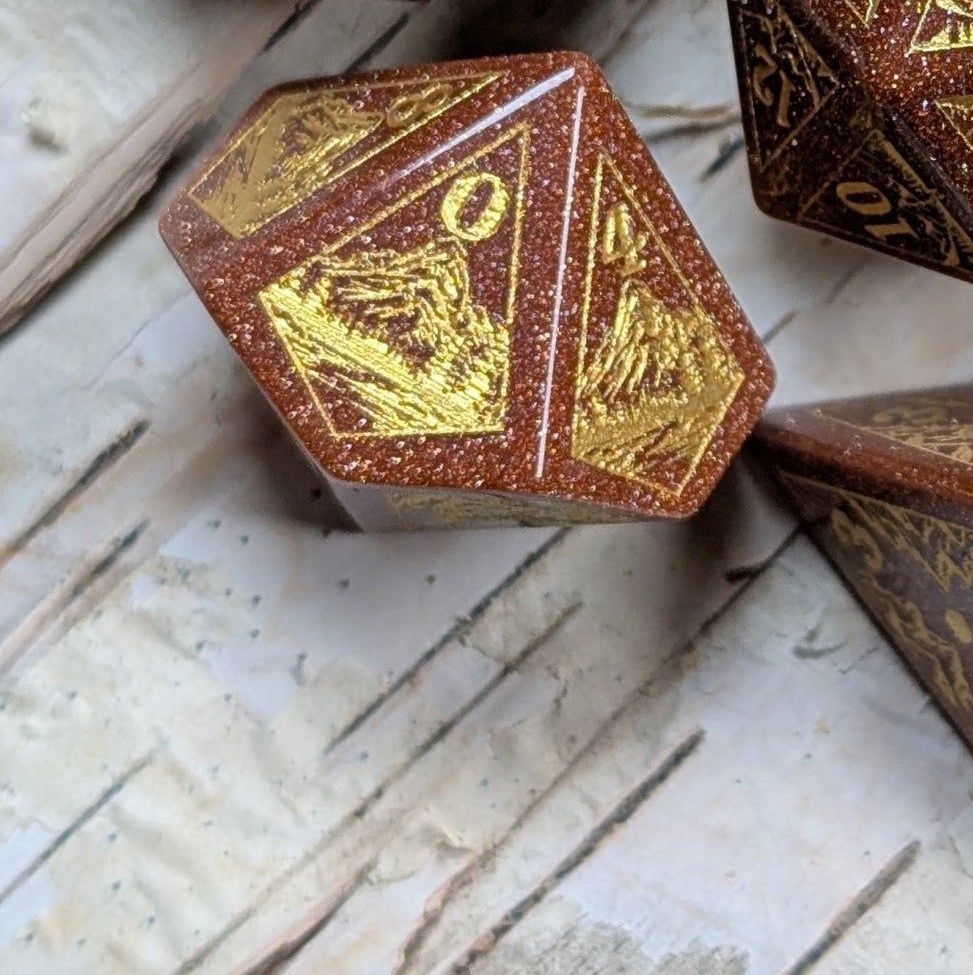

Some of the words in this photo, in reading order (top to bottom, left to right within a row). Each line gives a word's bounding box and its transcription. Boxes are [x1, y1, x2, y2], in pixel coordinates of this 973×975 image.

[439, 172, 511, 243] 0
[601, 201, 649, 277] 4
[835, 180, 919, 242] 10
